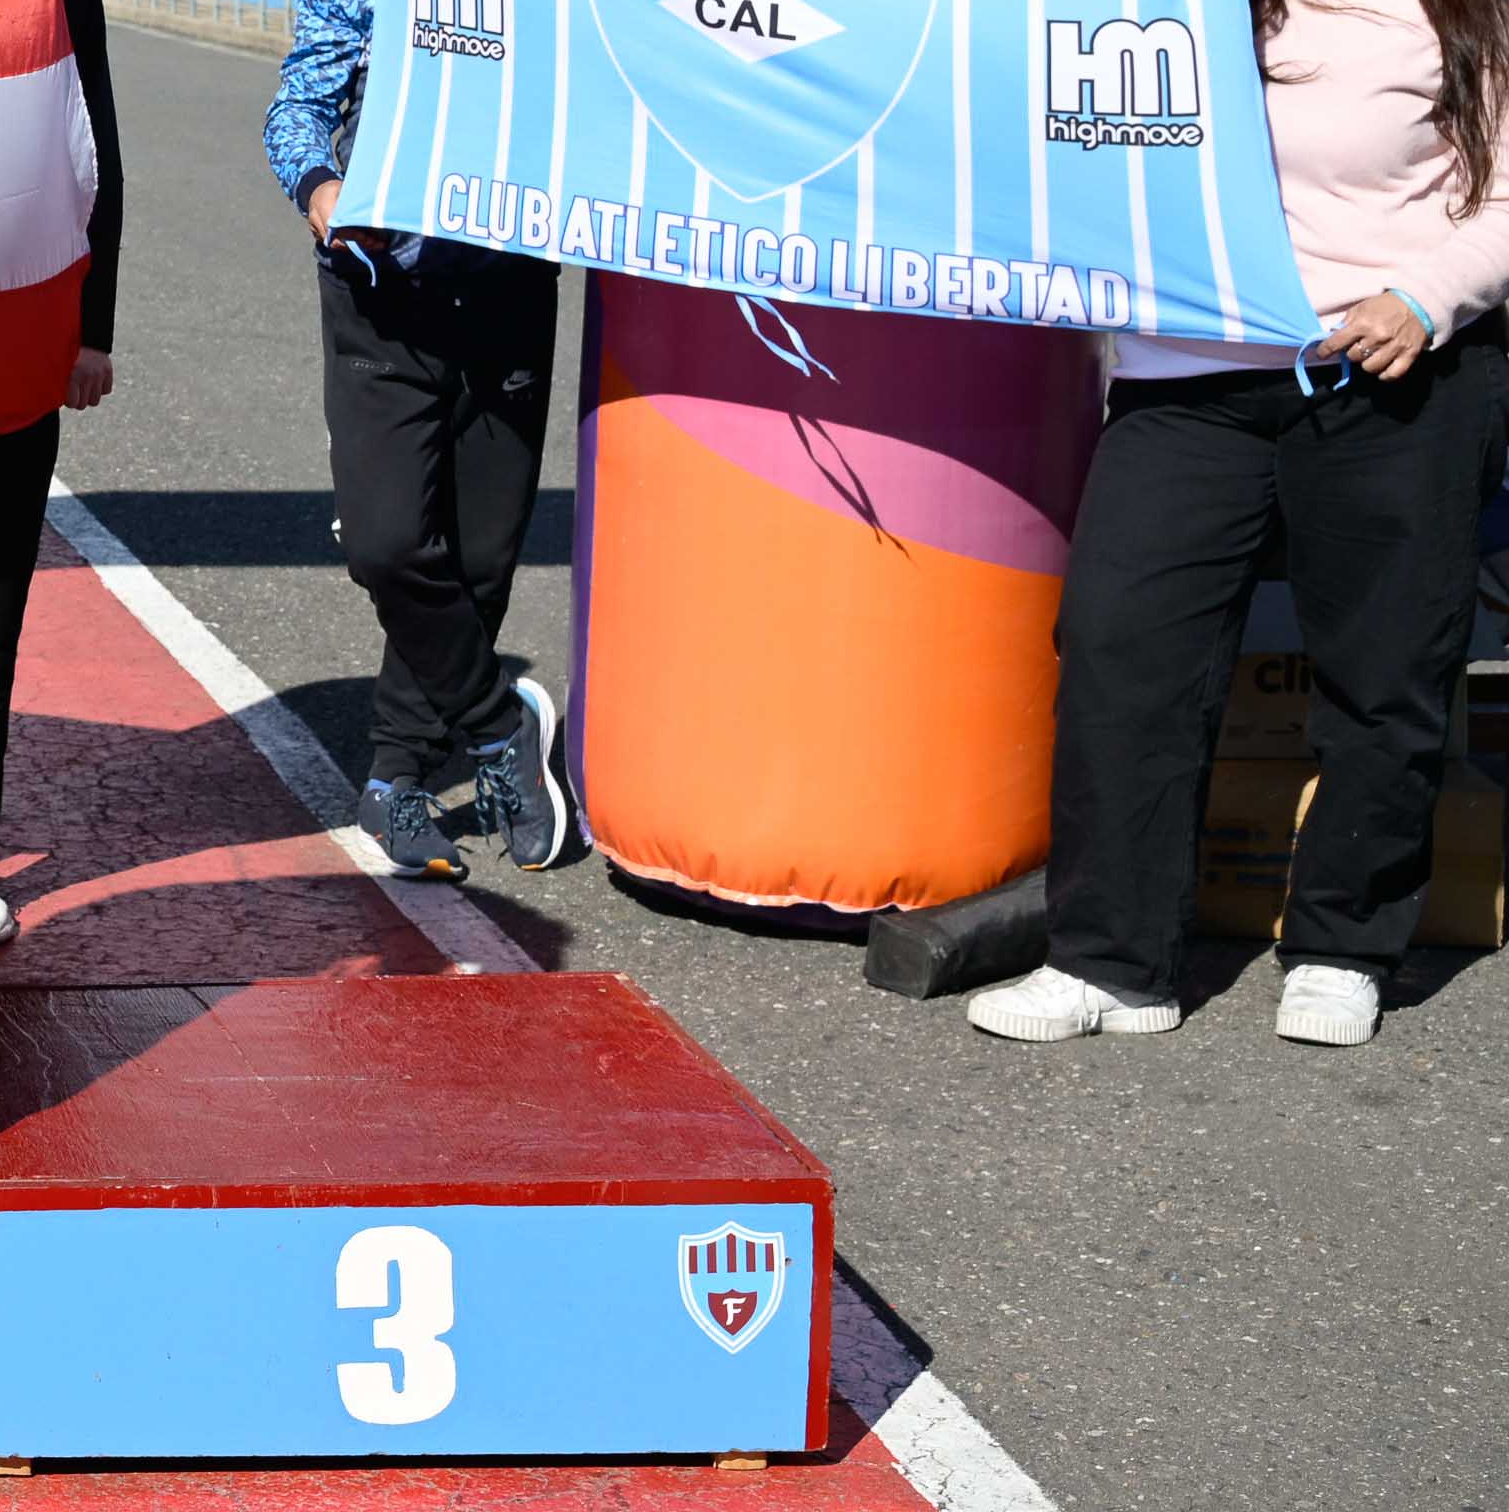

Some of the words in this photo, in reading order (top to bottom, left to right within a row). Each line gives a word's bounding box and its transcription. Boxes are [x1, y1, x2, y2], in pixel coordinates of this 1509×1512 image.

[412, 21, 506, 61] highmove
[1045, 113, 1204, 151] highmove
[437, 172, 551, 251] CLUB
[561, 194, 818, 294] ATLETICO
[830, 237, 1132, 331] LIBERTAD
[335, 1225, 458, 1426] 3
[722, 1297, 747, 1326] F
